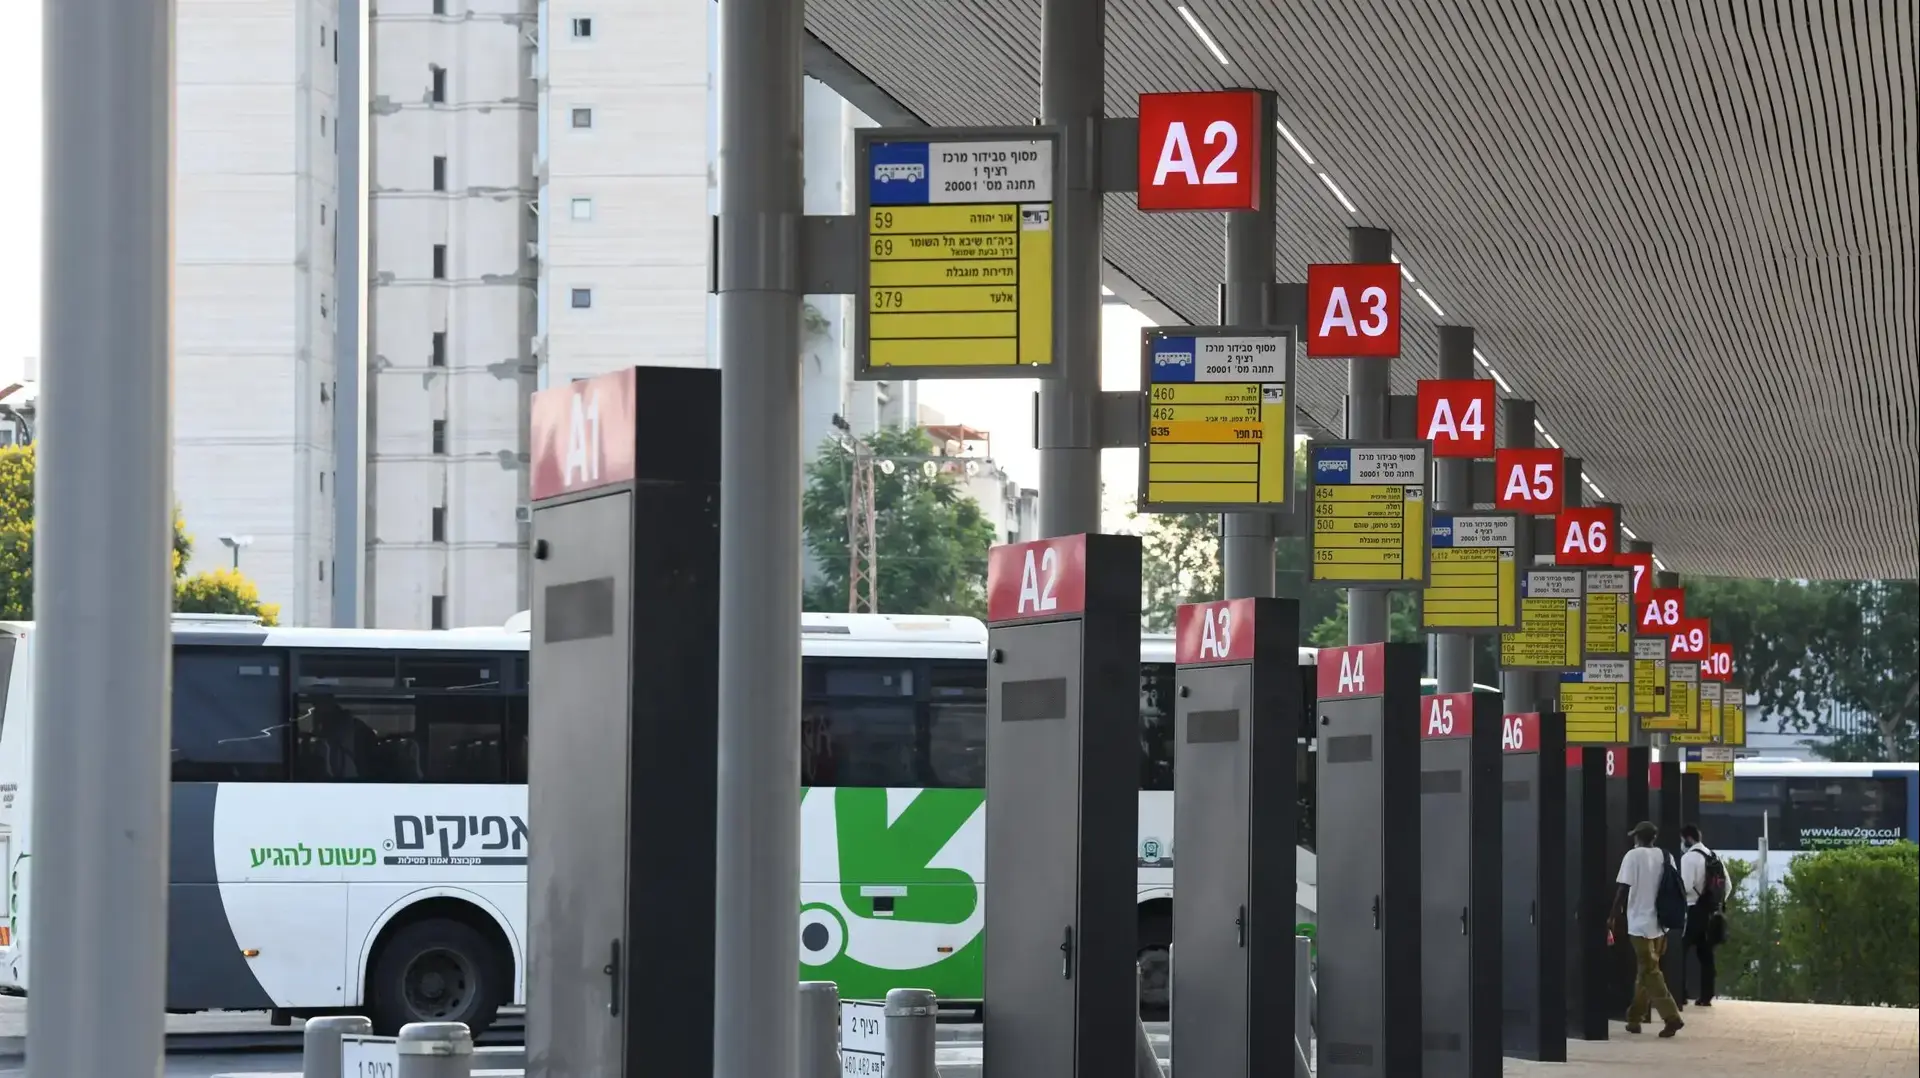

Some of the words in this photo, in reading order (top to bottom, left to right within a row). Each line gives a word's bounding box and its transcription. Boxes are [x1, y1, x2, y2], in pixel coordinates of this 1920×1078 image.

[942, 152, 968, 163] מרכז
[972, 151, 1006, 162] סבידור
[1011, 151, 1037, 164] מסוף
[1152, 120, 1238, 185] A2
[983, 166, 1007, 178] רציף
[945, 182, 977, 191] 20001
[1006, 180, 1035, 190] תחנה
[875, 212, 893, 229] 59
[970, 214, 995, 223] יהודה
[999, 214, 1013, 223] אור
[909, 238, 939, 247] השומר
[942, 236, 955, 247] תל
[958, 237, 983, 246] שיבא
[875, 239, 893, 256] 69
[951, 248, 976, 257] שמואל
[978, 248, 998, 256] גבעת
[946, 267, 979, 277] מוגבלת
[982, 267, 1013, 277] תדירות
[875, 291, 903, 308] 379
[990, 292, 1013, 303] אלעד
[1319, 286, 1388, 337] A3
[1205, 345, 1224, 353] מרכז
[1256, 344, 1276, 353] מסוף
[1236, 355, 1253, 364] רציף
[1206, 366, 1231, 374] 20001
[1153, 387, 1175, 400] 460
[1153, 408, 1174, 420] 462
[1246, 407, 1257, 415] לוד
[1427, 398, 1485, 441] A4
[1151, 427, 1170, 436] 635
[1233, 429, 1250, 439] חפר
[1252, 429, 1263, 439] בת
[564, 389, 599, 487] A1
[1503, 463, 1554, 500] A5
[1316, 488, 1333, 498] 454
[1316, 505, 1333, 514] 458
[1317, 520, 1334, 529] 500
[1562, 521, 1607, 553] A6
[1316, 551, 1333, 560] 155
[1018, 547, 1057, 614] A2
[1643, 599, 1679, 625] A8
[1200, 608, 1231, 659] A3
[1671, 628, 1703, 652] A9
[1700, 652, 1730, 675] A10
[1338, 650, 1365, 693] A4
[1428, 699, 1454, 735] A5
[1502, 718, 1523, 750] A6
[1606, 750, 1615, 776] 8
[394, 815, 528, 857] אפיקים
[1800, 826, 1901, 839] www.kav2go.co.il
[250, 843, 312, 868] להגיע
[318, 847, 377, 866] פשוט
[398, 857, 427, 865] מסילות
[428, 857, 448, 865] אמנון
[450, 857, 481, 865] מקבוצת
[852, 1017, 857, 1032] 2
[860, 1018, 879, 1039] רציף
[368, 1061, 393, 1078] רציף
